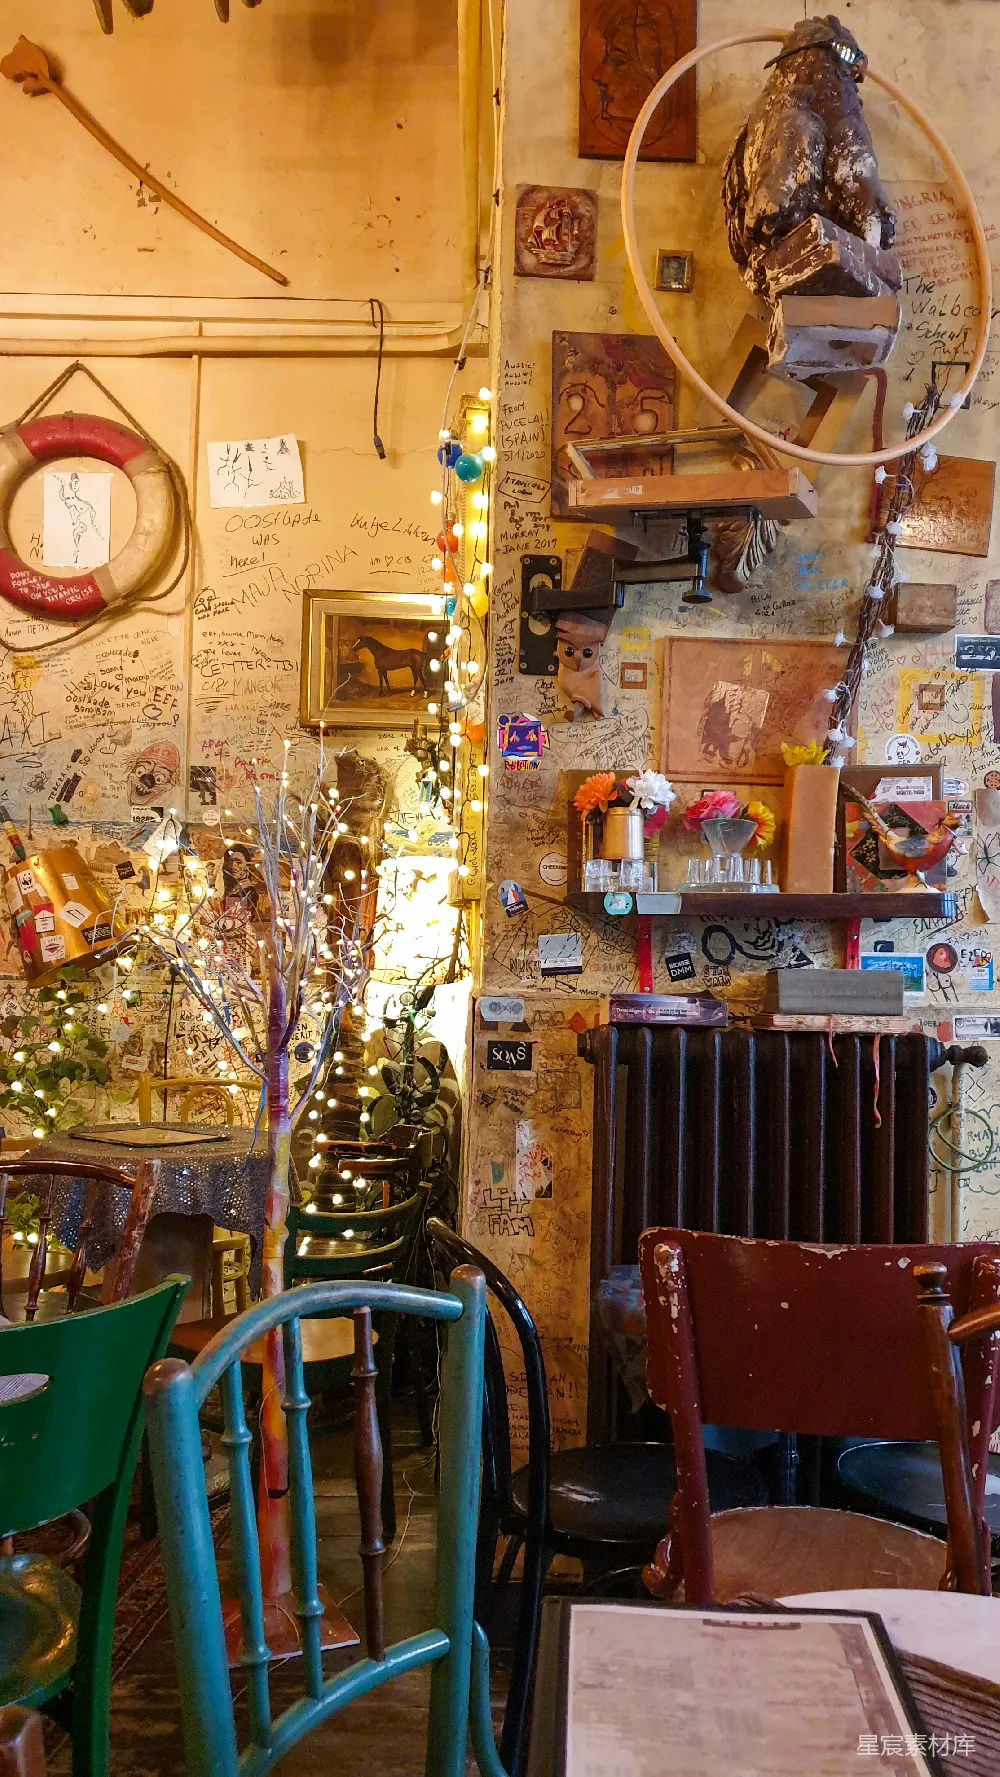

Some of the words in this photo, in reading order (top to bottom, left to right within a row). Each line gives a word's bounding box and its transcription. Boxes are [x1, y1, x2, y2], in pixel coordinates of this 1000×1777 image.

[902, 276, 936, 294] The
[502, 402, 525, 417] FROM
[501, 427, 545, 448] (SPAIN)
[252, 534, 280, 545] WAS
[65, 585, 94, 605] CRUISE
[488, 1213, 534, 1237] FAM
